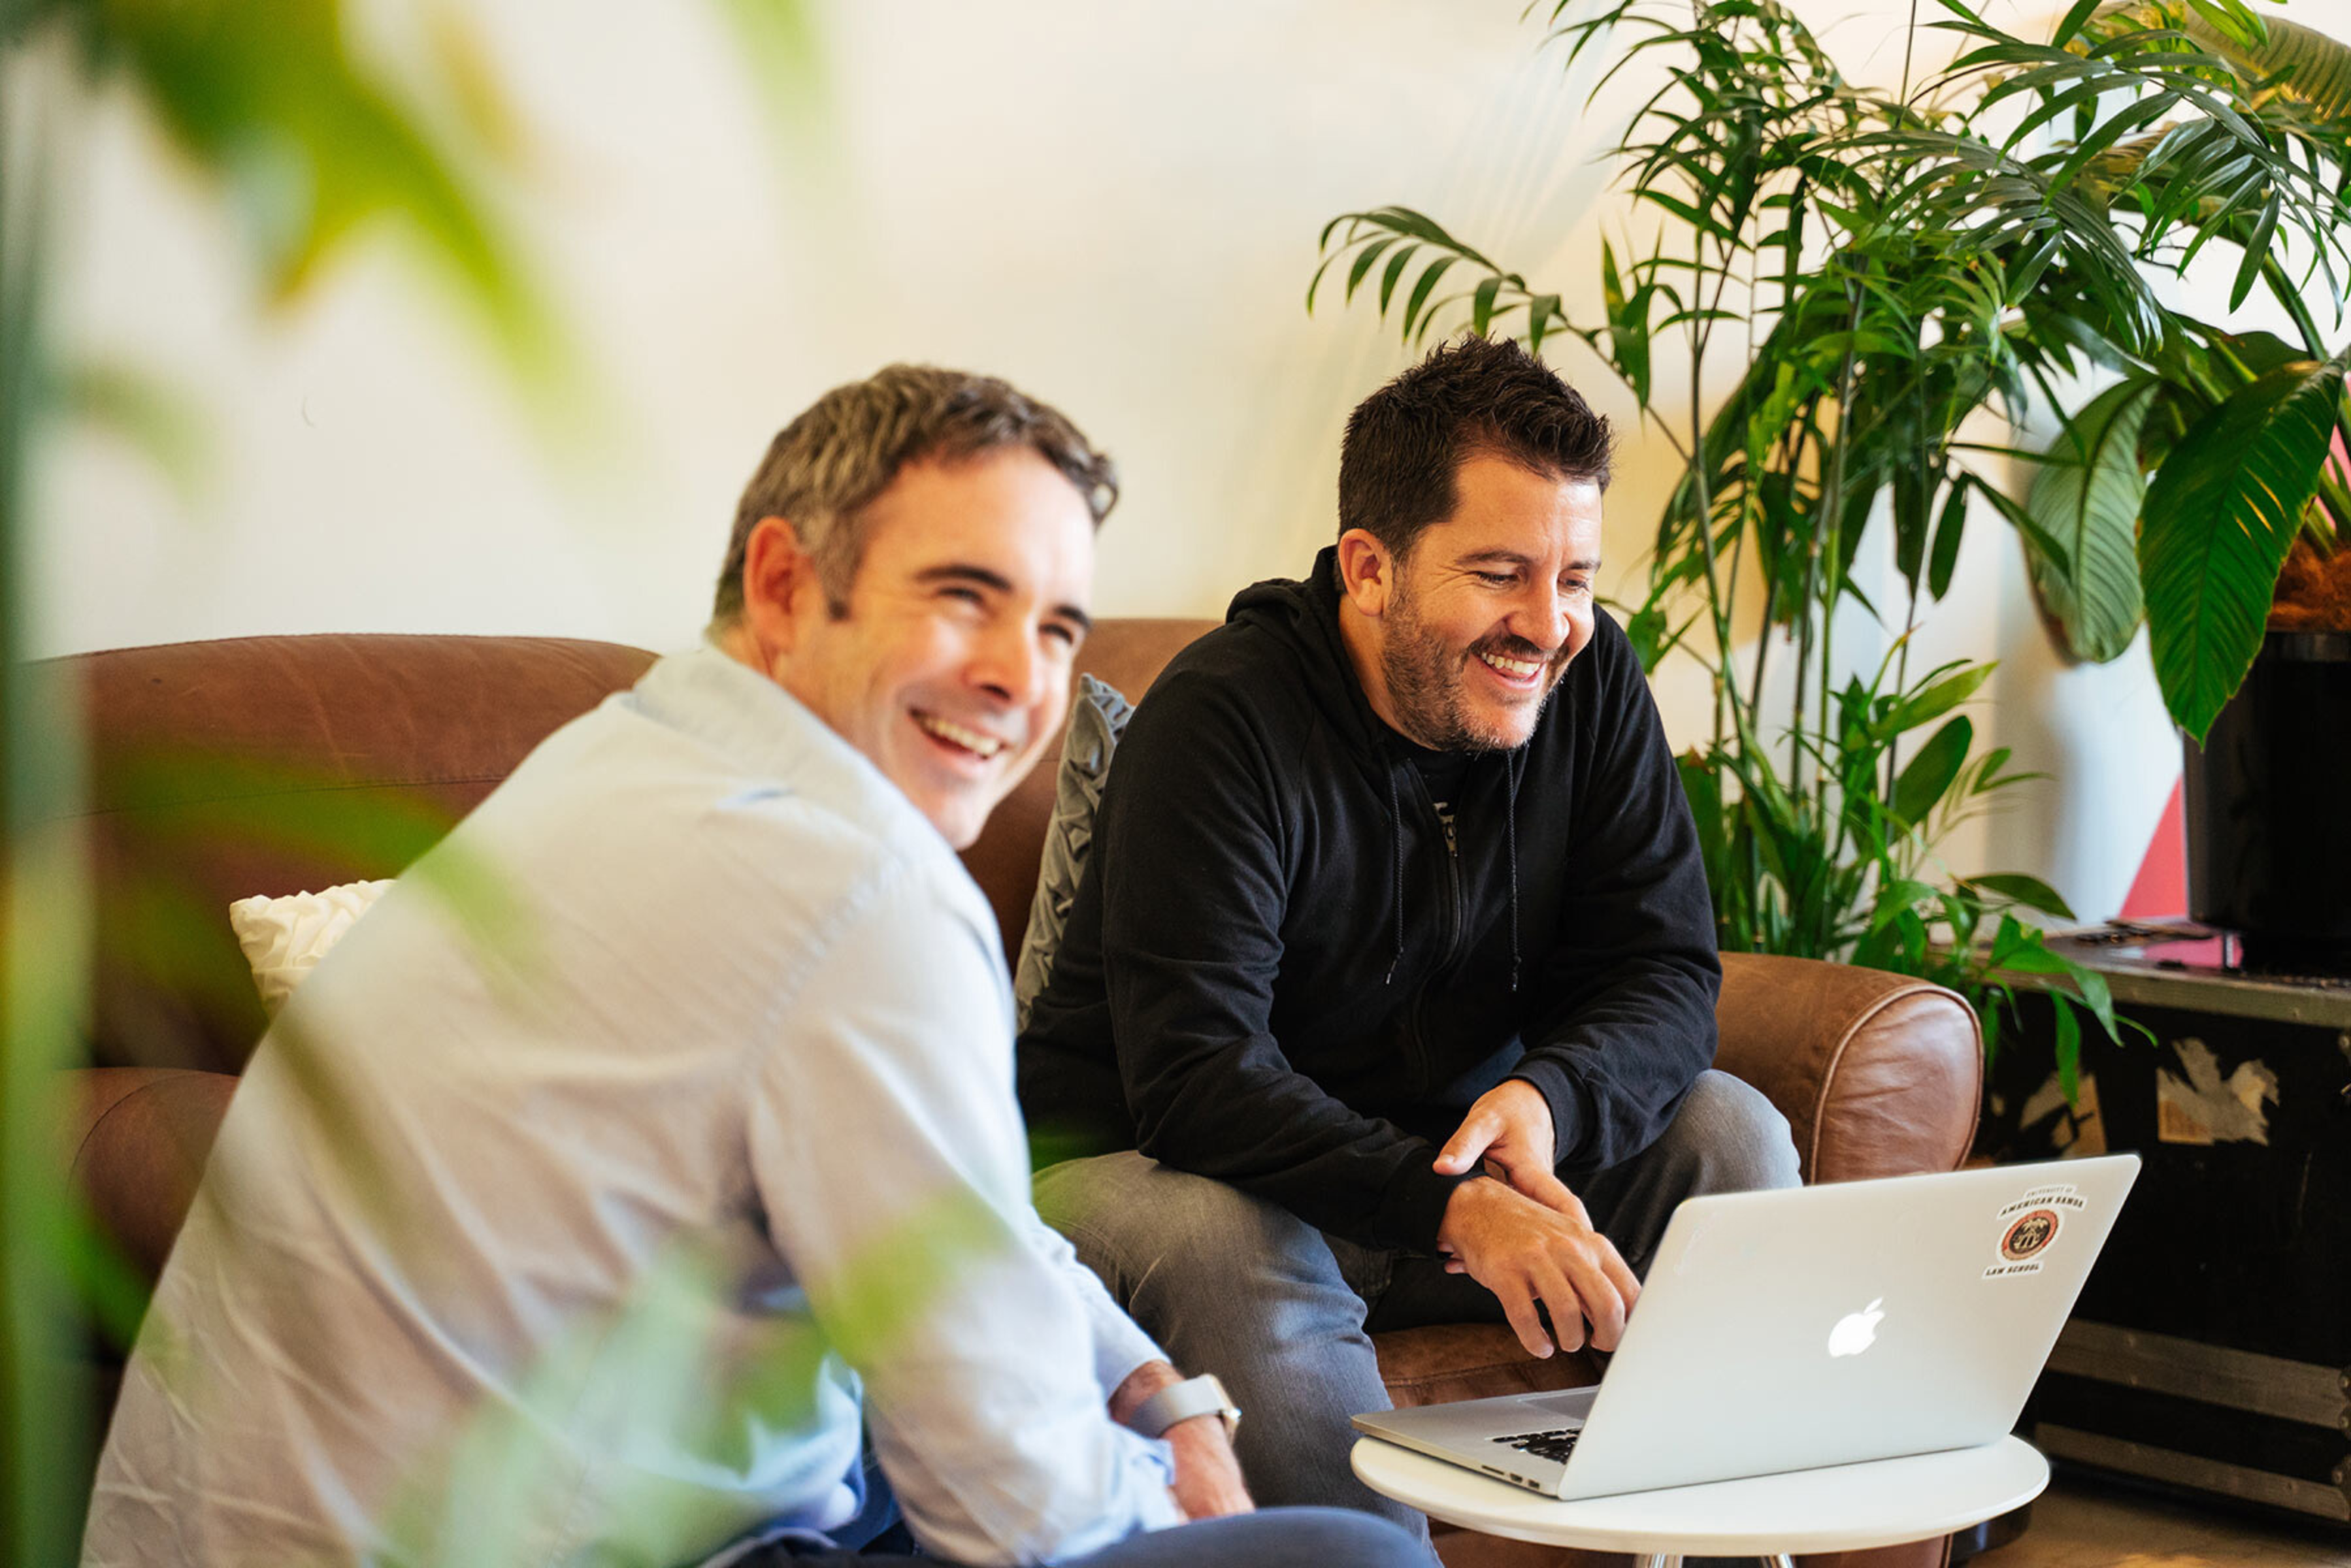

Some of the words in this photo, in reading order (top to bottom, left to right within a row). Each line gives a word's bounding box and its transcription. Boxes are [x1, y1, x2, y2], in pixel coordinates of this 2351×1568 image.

[2001, 1196, 2053, 1216] AMERICAN
[2054, 1196, 2084, 1208] SAMOA
[1986, 1267, 2005, 1277] LAW
[2007, 1264, 2039, 1274] SCHOOL
